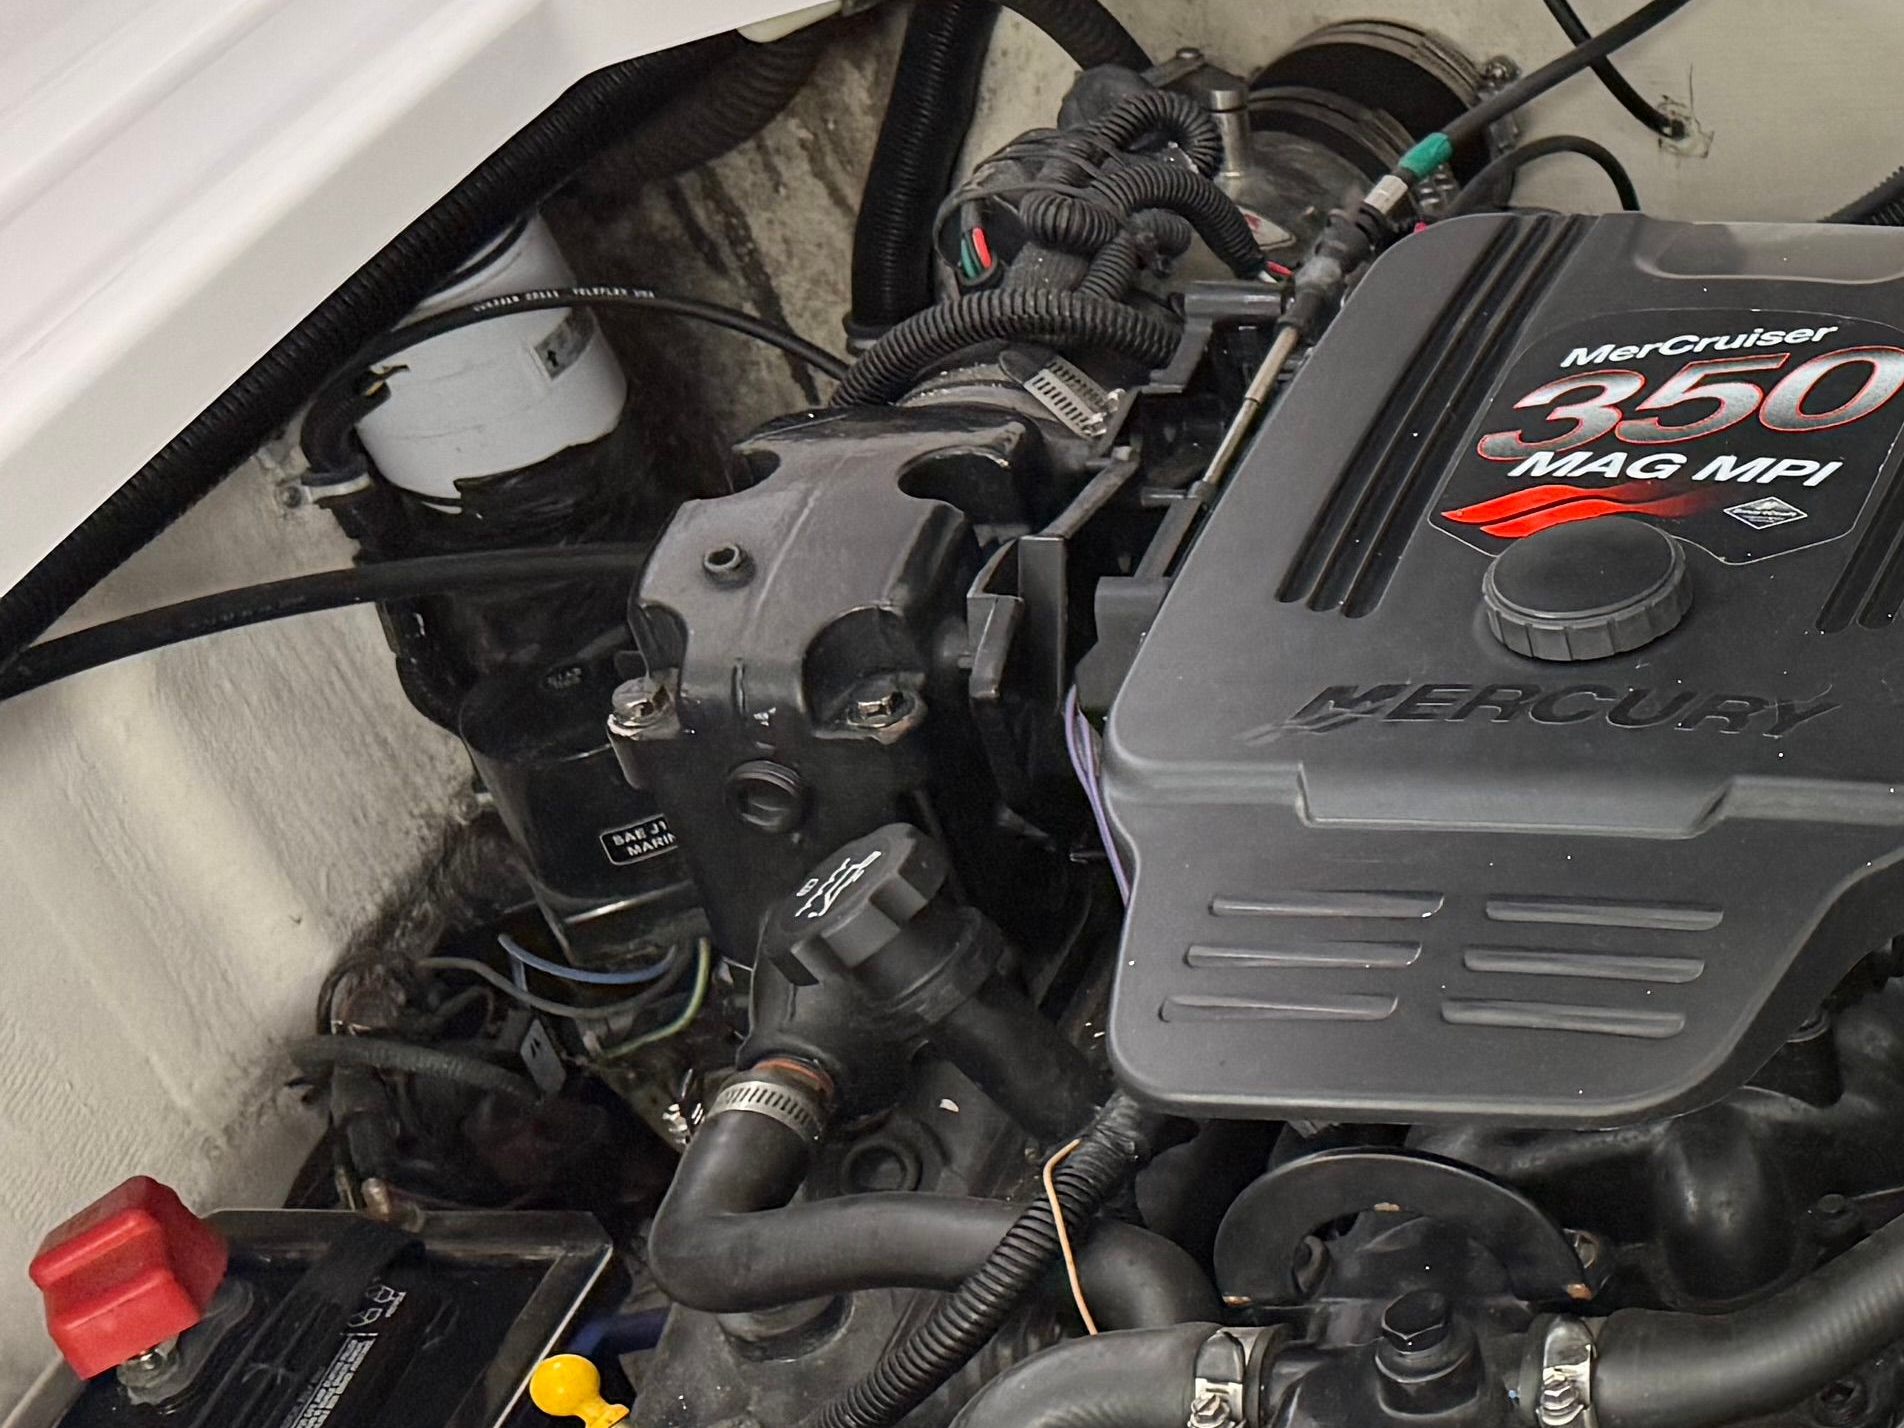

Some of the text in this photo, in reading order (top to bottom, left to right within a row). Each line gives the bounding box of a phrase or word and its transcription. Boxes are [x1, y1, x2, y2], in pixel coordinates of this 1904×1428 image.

[1559, 325, 1838, 369] MerCruiser
[1508, 450, 1843, 487] MAG MPI
[1287, 682, 1842, 738] MERCURY
